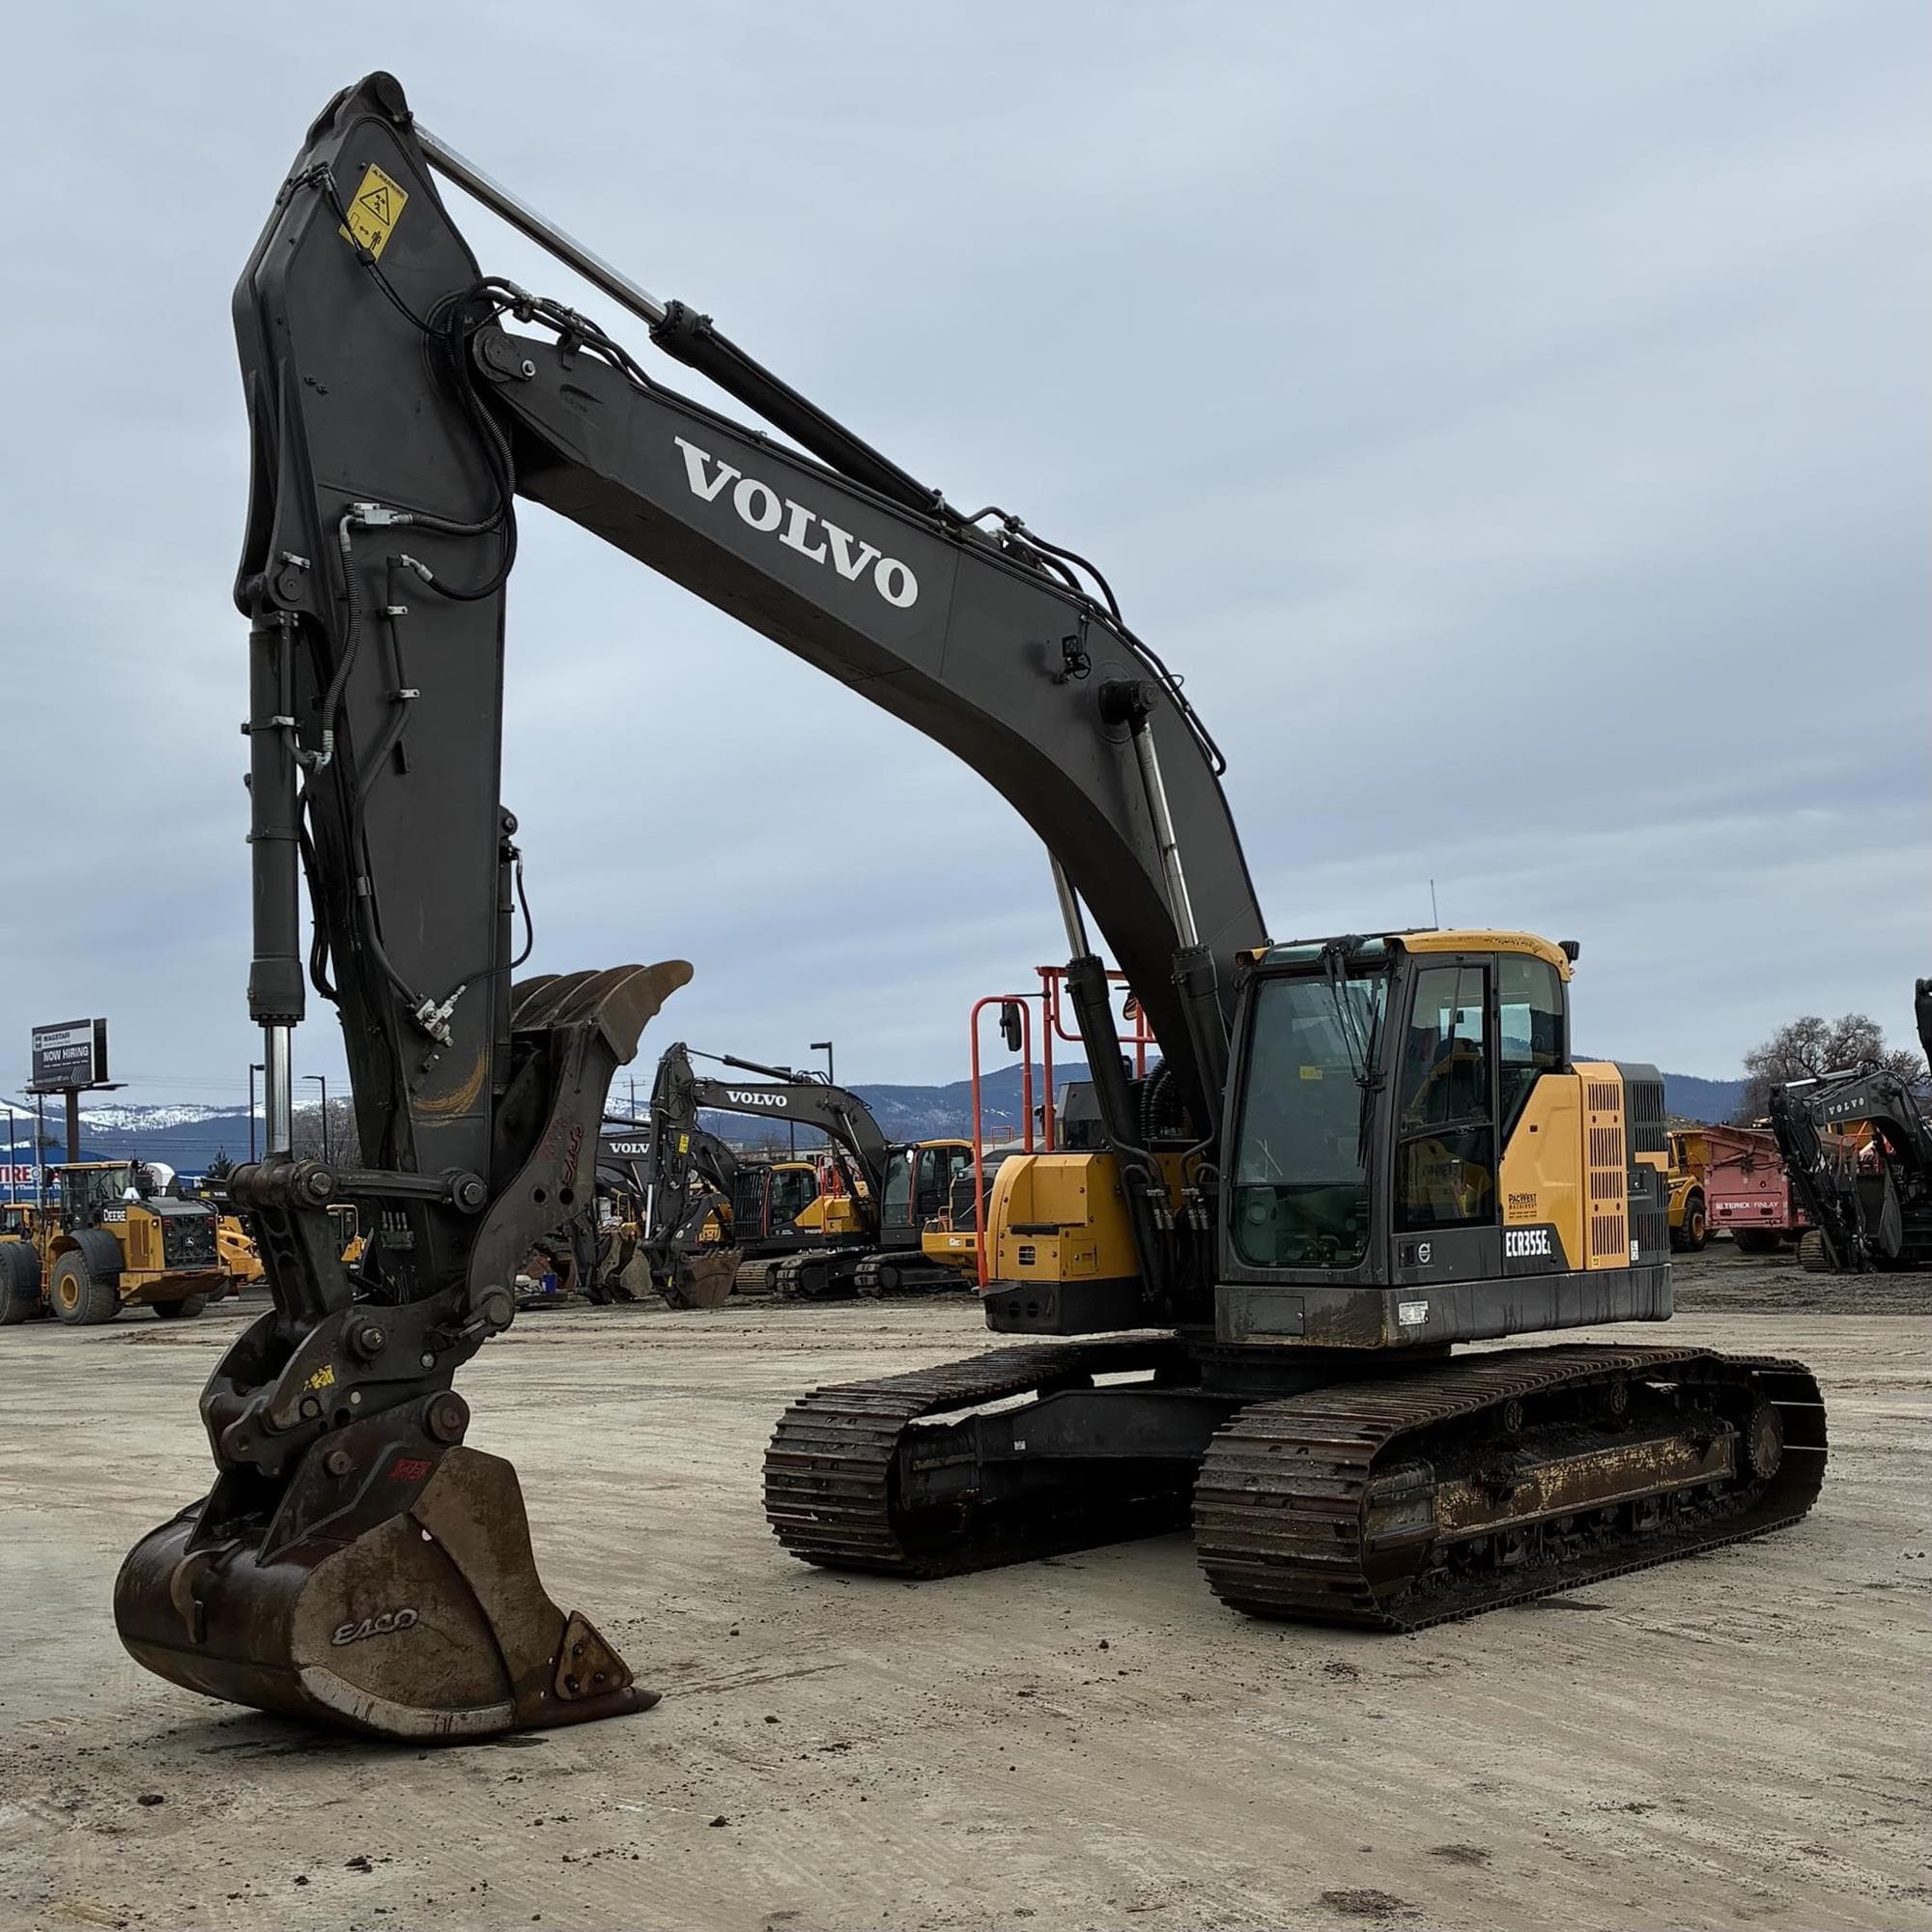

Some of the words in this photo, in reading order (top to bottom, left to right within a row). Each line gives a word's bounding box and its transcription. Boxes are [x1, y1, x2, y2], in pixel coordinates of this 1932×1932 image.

[674, 436, 919, 608] VOLVO
[43, 1050, 61, 1062] NOW
[63, 1046, 89, 1059] HIRING
[726, 1091, 787, 1107] VOLVO
[1829, 1097, 1864, 1116] VOLVO
[610, 1143, 649, 1153] VOLV
[103, 1208, 127, 1221] DEERE
